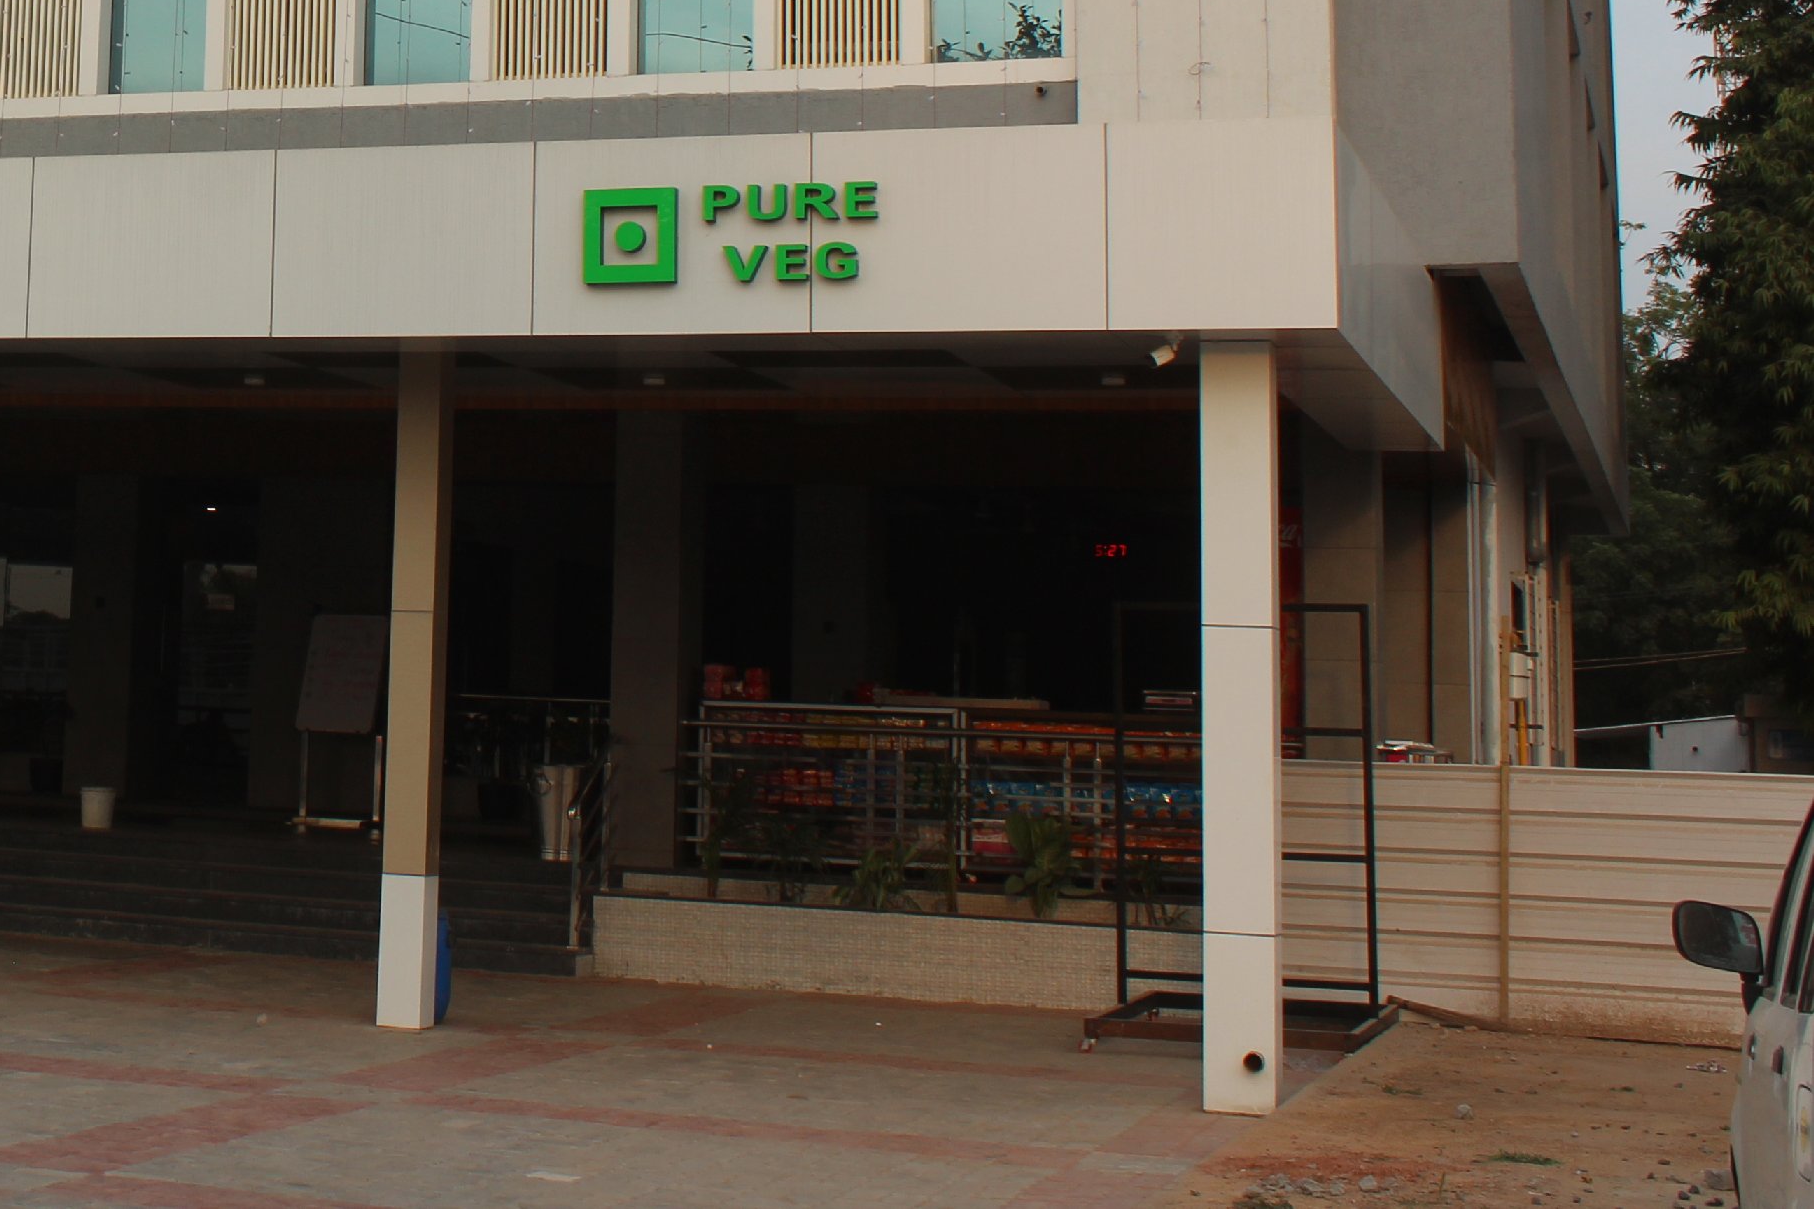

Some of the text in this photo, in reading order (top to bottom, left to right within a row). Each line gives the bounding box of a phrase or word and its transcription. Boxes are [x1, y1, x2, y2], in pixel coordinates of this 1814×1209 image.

[702, 181, 879, 223] PURE
[723, 242, 859, 283] VEG
[1095, 544, 1127, 557] 5:27
